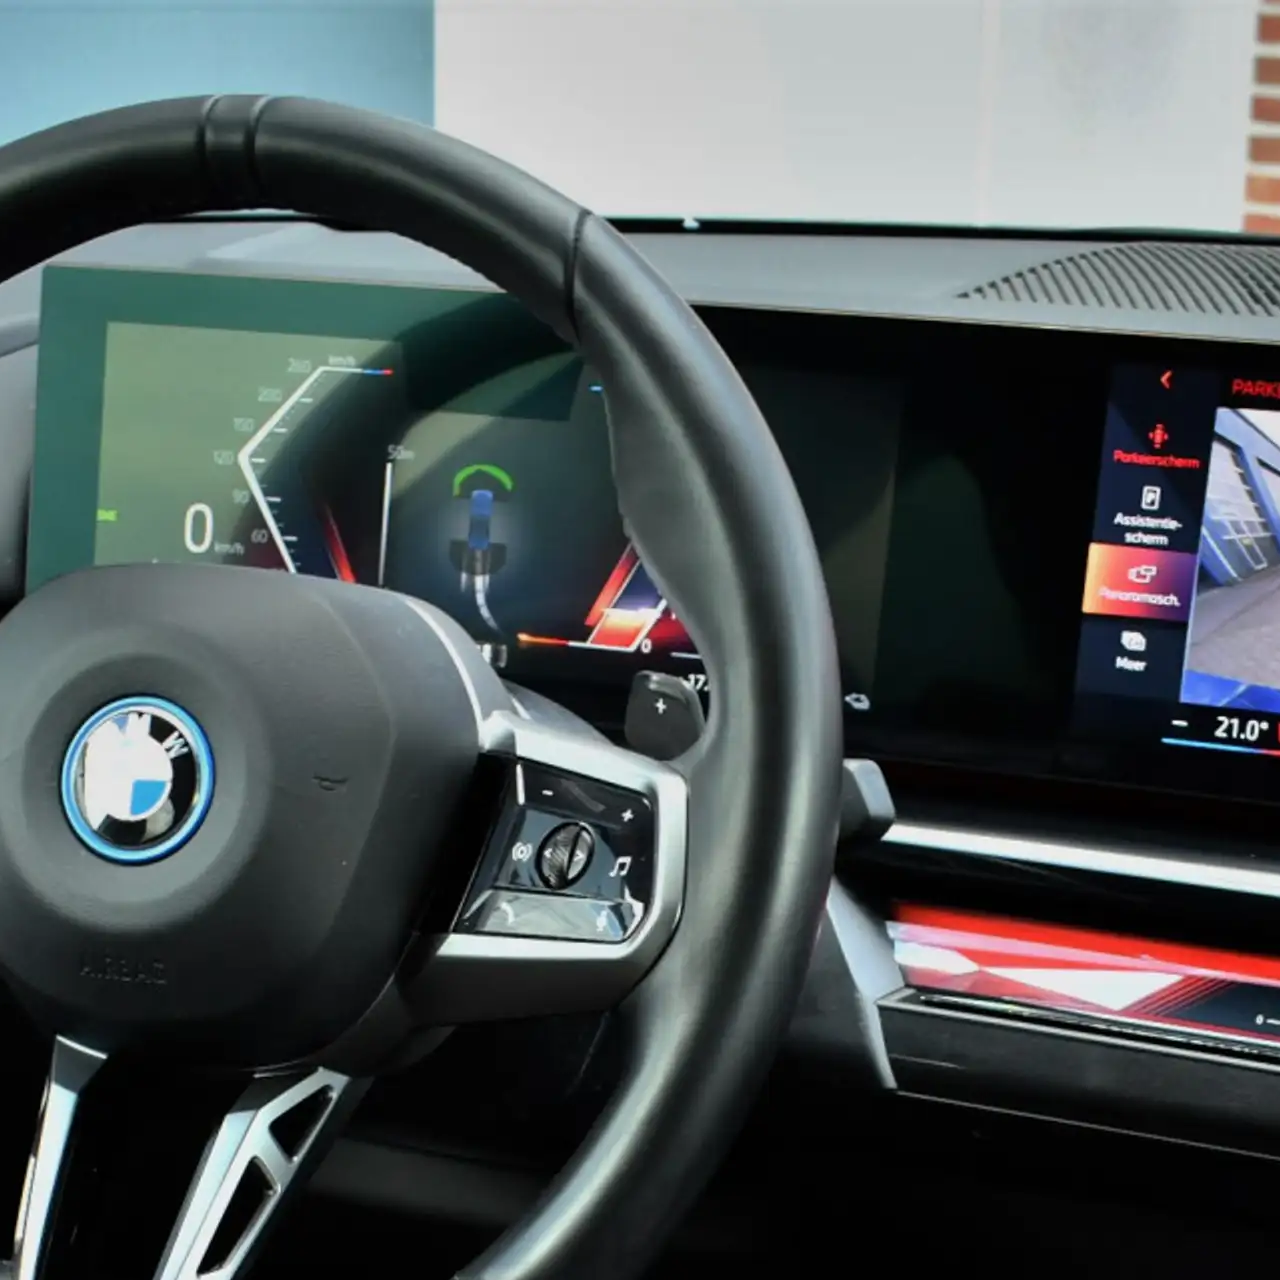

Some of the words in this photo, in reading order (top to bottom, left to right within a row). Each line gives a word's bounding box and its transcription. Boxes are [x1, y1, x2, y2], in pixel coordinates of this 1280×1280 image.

[184, 502, 213, 553] 0
[250, 529, 268, 543] 60
[1124, 531, 1169, 546] scherm
[640, 639, 652, 653] 0
